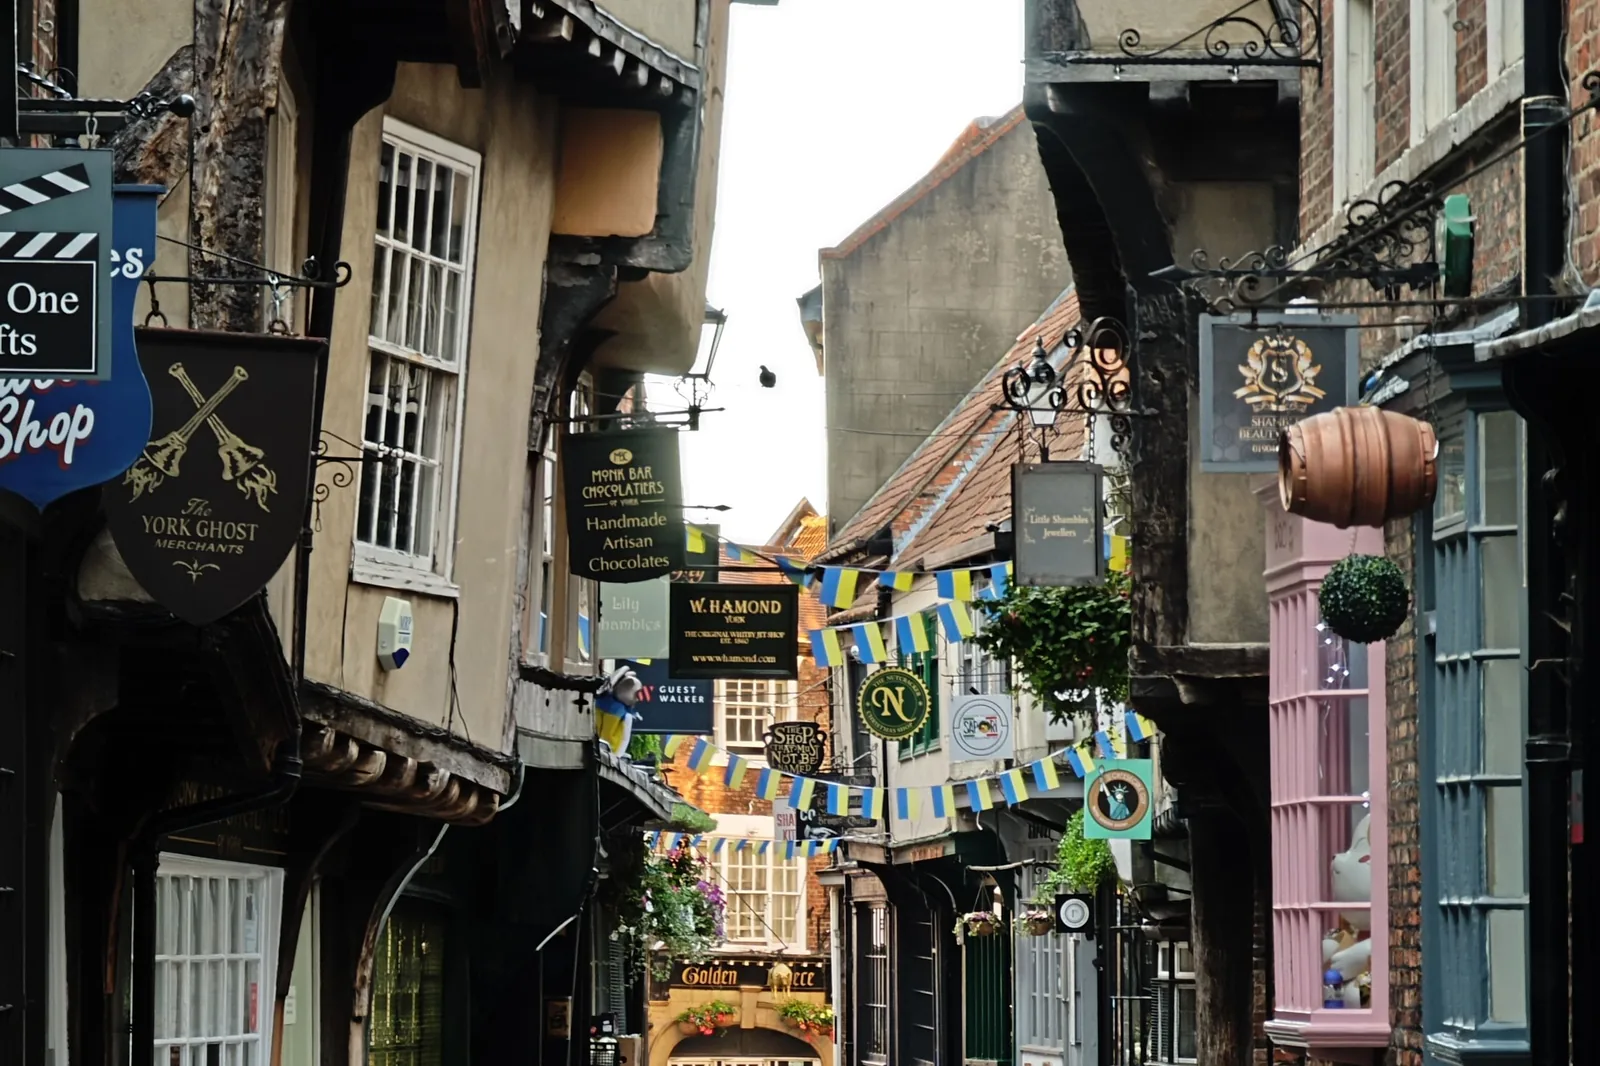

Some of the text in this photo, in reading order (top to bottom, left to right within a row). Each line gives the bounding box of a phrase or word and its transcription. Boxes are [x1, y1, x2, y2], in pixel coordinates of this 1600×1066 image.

[7, 282, 80, 314] One
[592, 466, 653, 483] MONK BAR
[582, 481, 665, 499] CHOCOLATIERS
[181, 497, 213, 517] The
[586, 511, 668, 531] Handmade
[1030, 514, 1089, 524] Little Shambles
[142, 515, 259, 541] YORK GHOST
[1043, 527, 1077, 540] Jewellers
[155, 539, 245, 555] MERCHANTS
[603, 535, 653, 550] Artisan
[589, 553, 670, 572] Chocolates
[689, 597, 782, 614] W. HAMOND
[600, 618, 661, 631] hambles
[658, 685, 697, 694] GUEST
[659, 695, 705, 703] WALKER
[871, 686, 917, 722] N
[774, 726, 815, 745] SHOP
[682, 966, 737, 986] Golden
